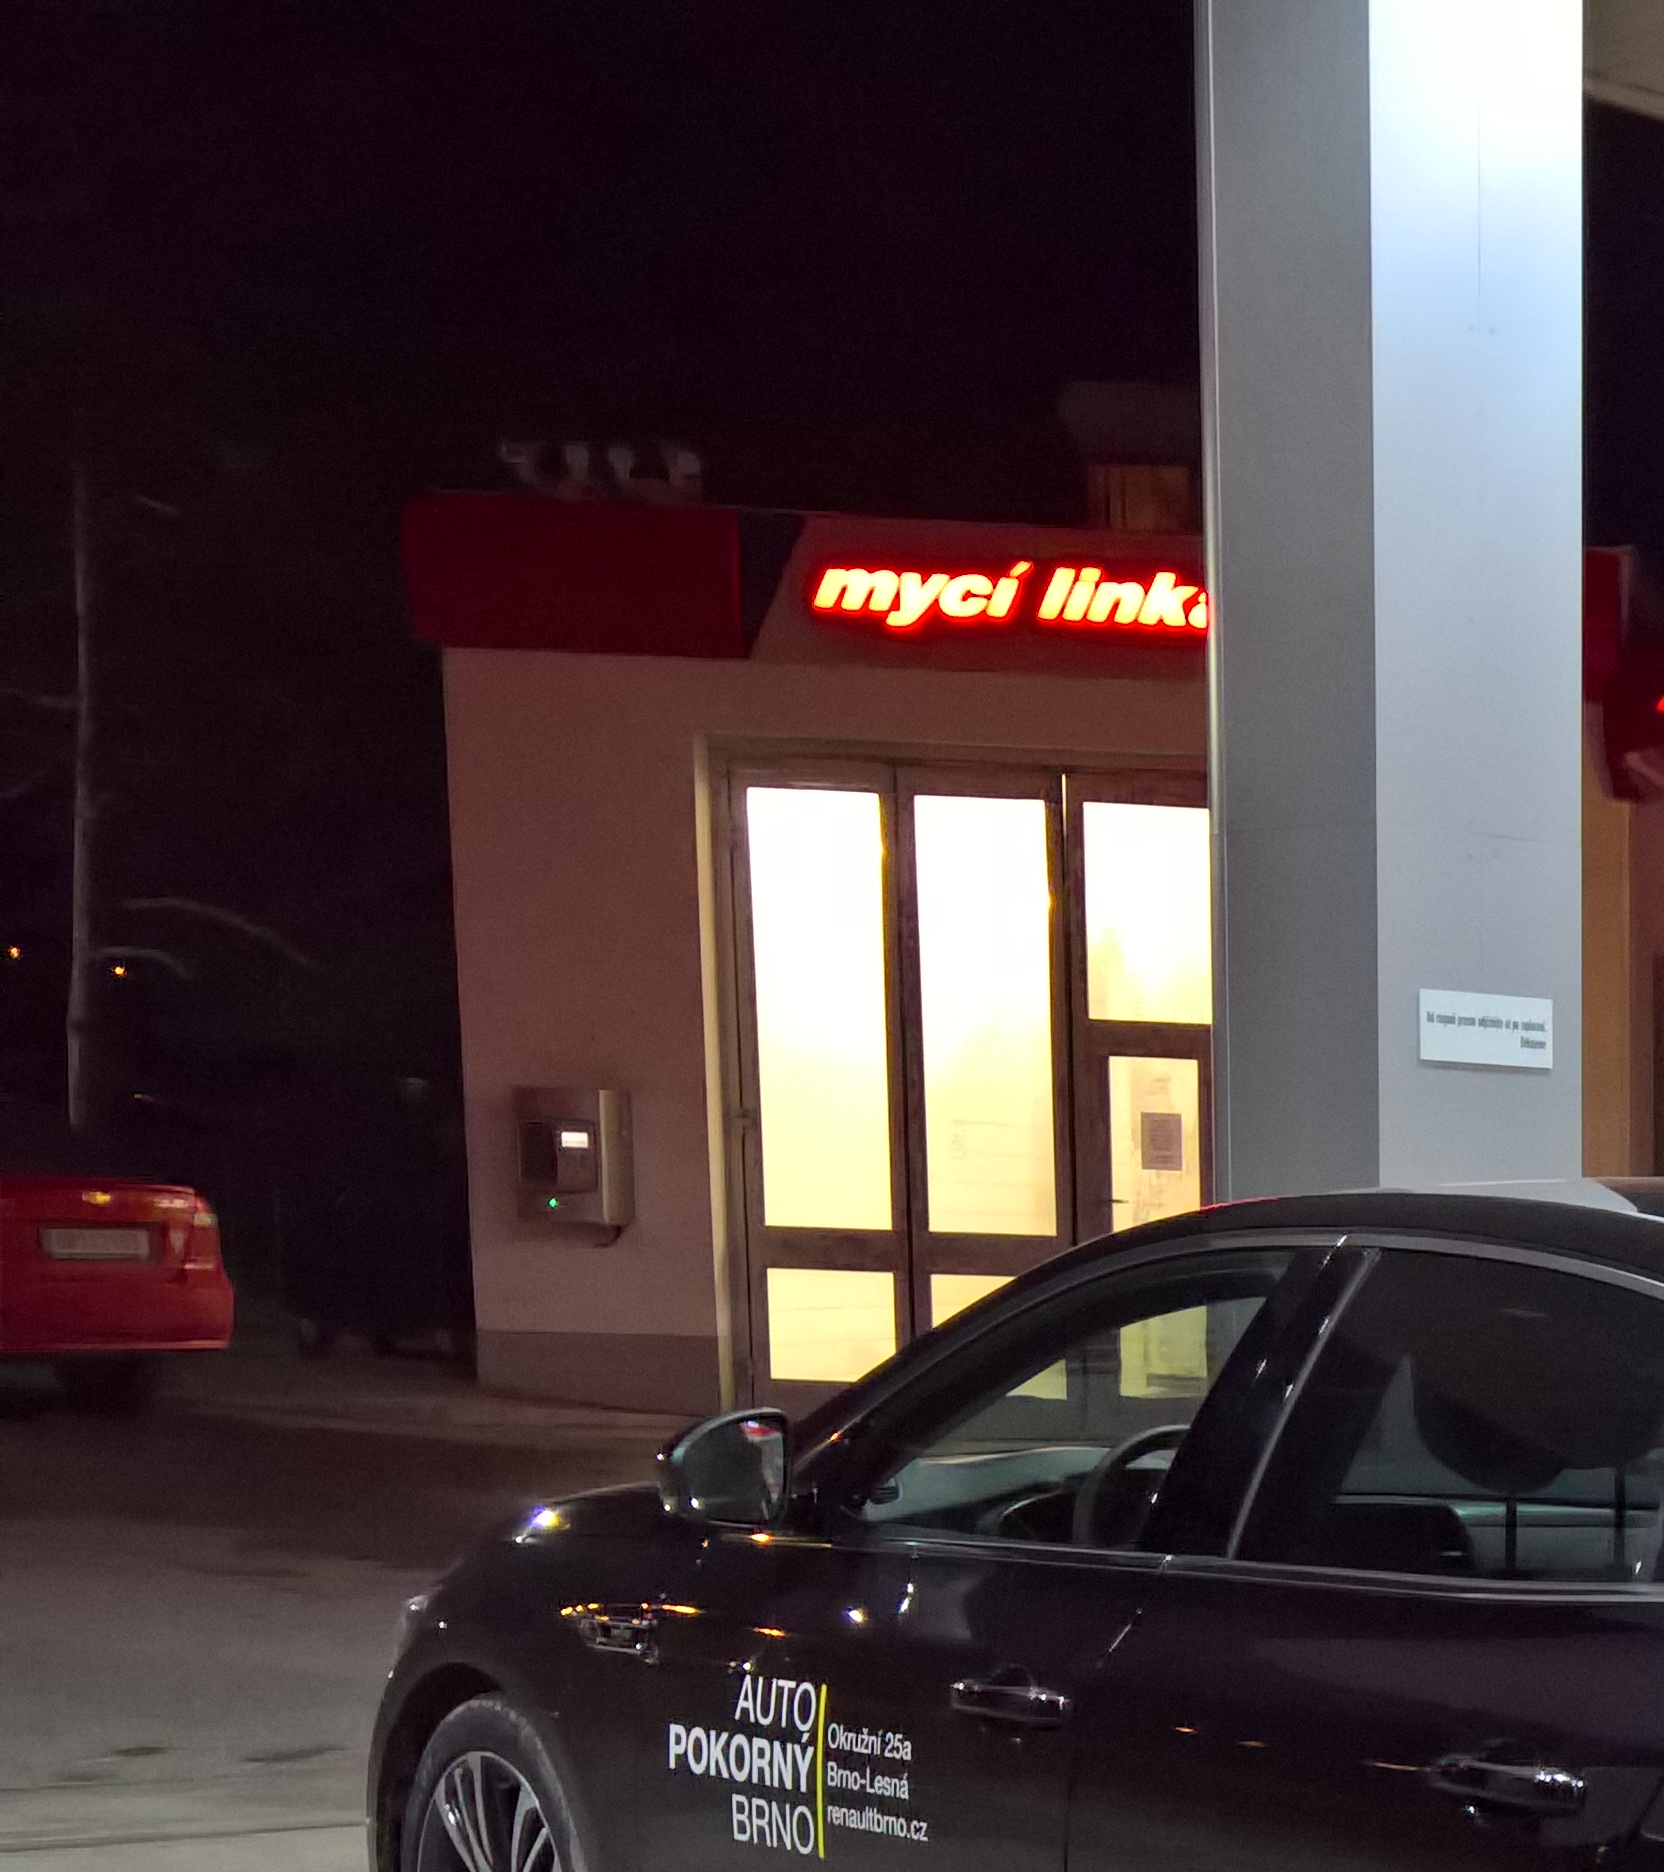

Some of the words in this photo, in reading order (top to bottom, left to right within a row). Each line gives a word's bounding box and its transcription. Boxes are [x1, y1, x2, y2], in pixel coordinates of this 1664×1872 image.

[812, 559, 1034, 628] mycí
[734, 1673, 818, 1733] AUTO
[667, 1722, 816, 1794] POKORNÝ
[827, 1722, 883, 1757] Okružní
[883, 1732, 912, 1762] 25a
[826, 1761, 911, 1801] Brno-Lesná
[731, 1793, 817, 1855] BRNO
[826, 1805, 930, 1843] renaultbrno.cz
